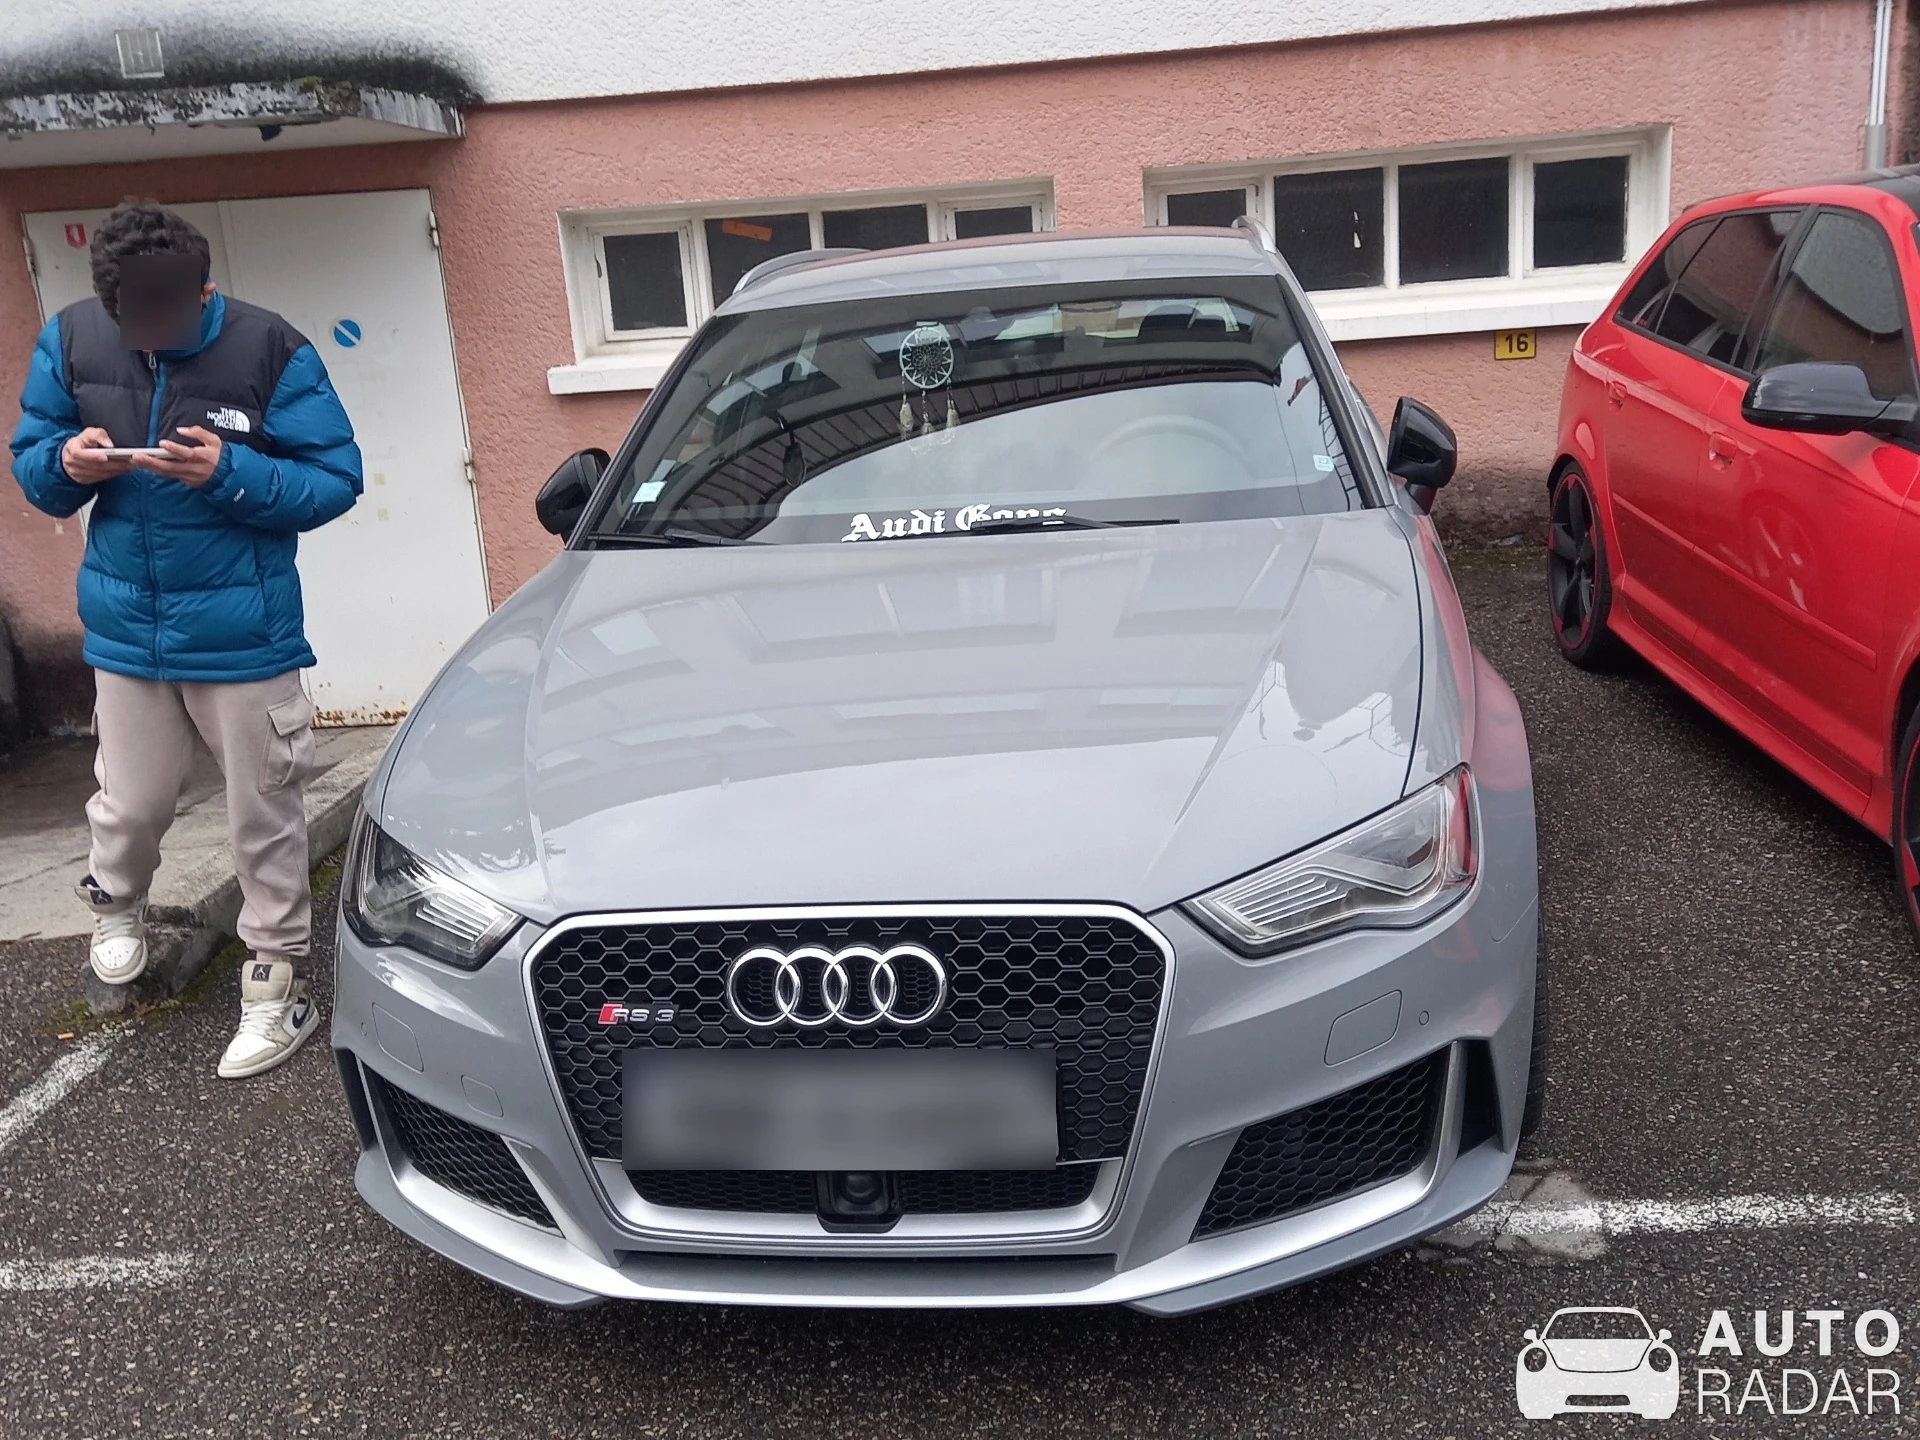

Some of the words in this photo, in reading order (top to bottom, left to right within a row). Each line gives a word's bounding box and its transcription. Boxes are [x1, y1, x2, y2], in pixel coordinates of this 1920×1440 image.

[1505, 333, 1529, 353] 16
[206, 410, 236, 423] NORTH
[220, 406, 236, 417] THE
[214, 419, 235, 430] FACE
[841, 509, 946, 543] Audi
[608, 1007, 650, 1022] RS
[655, 1008, 675, 1022] 3
